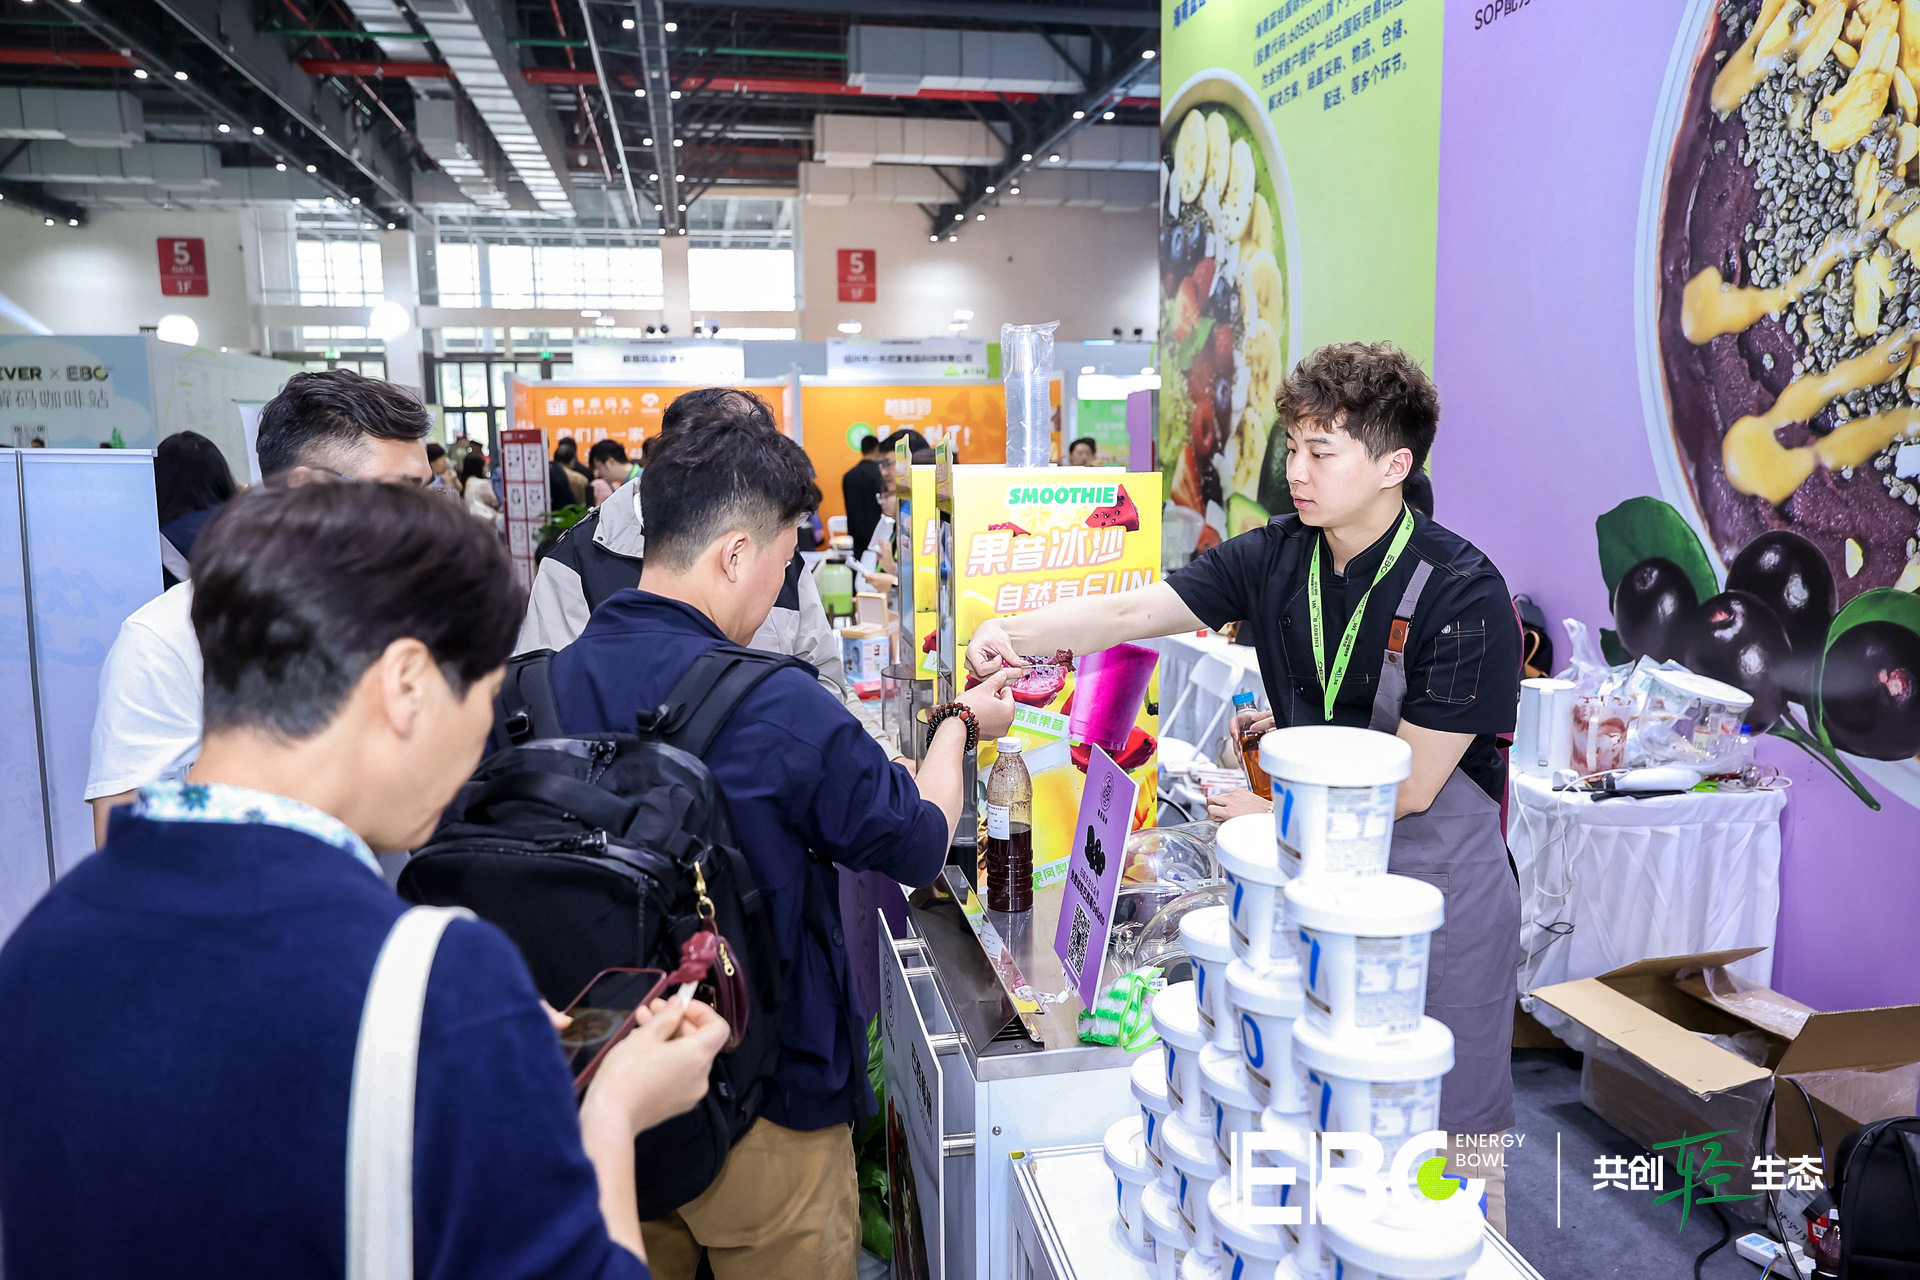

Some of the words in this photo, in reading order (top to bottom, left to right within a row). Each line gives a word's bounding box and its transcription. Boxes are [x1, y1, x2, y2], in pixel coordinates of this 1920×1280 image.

[174, 241, 191, 265] 5
[850, 252, 865, 274] 5
[1009, 487, 1115, 505] SMOOTHIE
[967, 526, 1124, 576] 果昔冰沙
